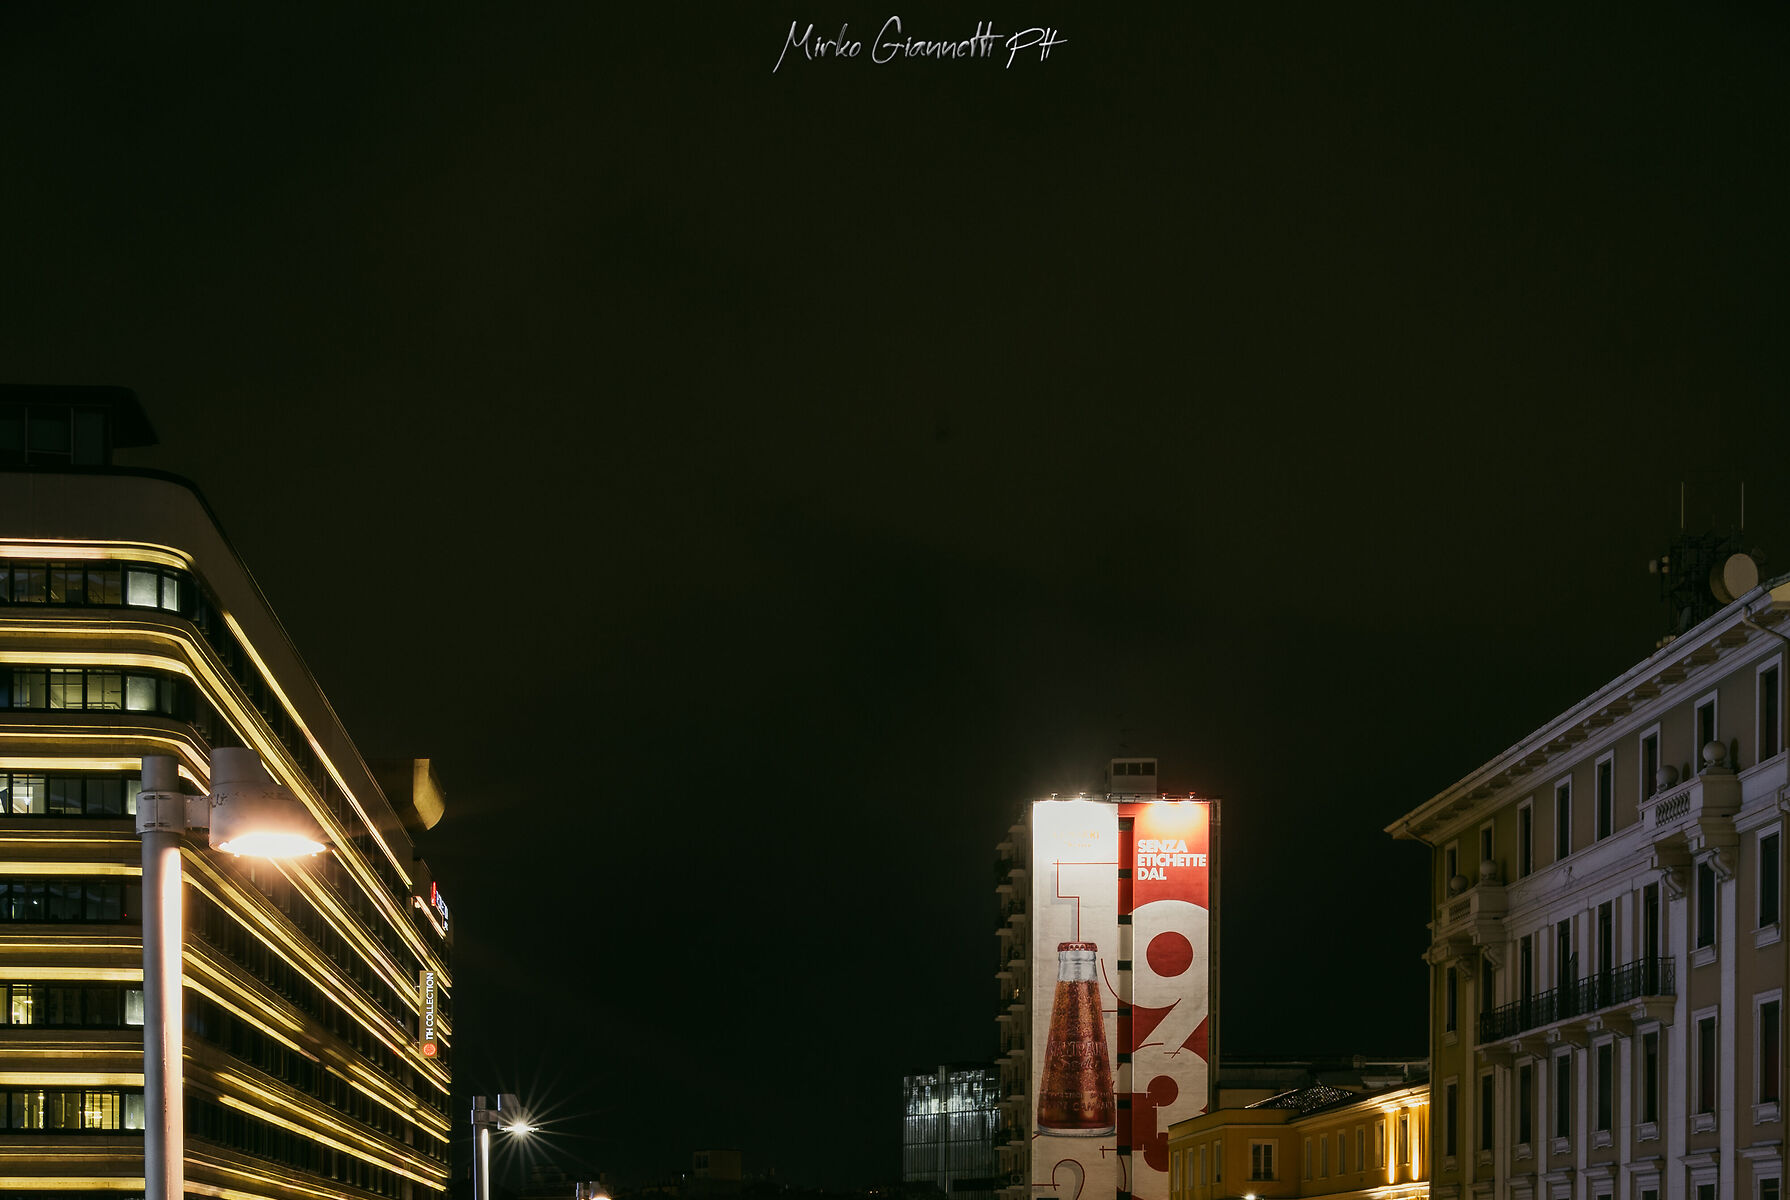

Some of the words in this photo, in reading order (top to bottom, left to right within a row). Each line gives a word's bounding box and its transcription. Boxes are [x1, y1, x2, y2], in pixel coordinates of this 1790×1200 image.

[1137, 839, 1188, 853] SENZA
[1137, 853, 1207, 867] ETICHETTE
[1137, 867, 1167, 881] DAL
[426, 972, 434, 1027] COLLECTION
